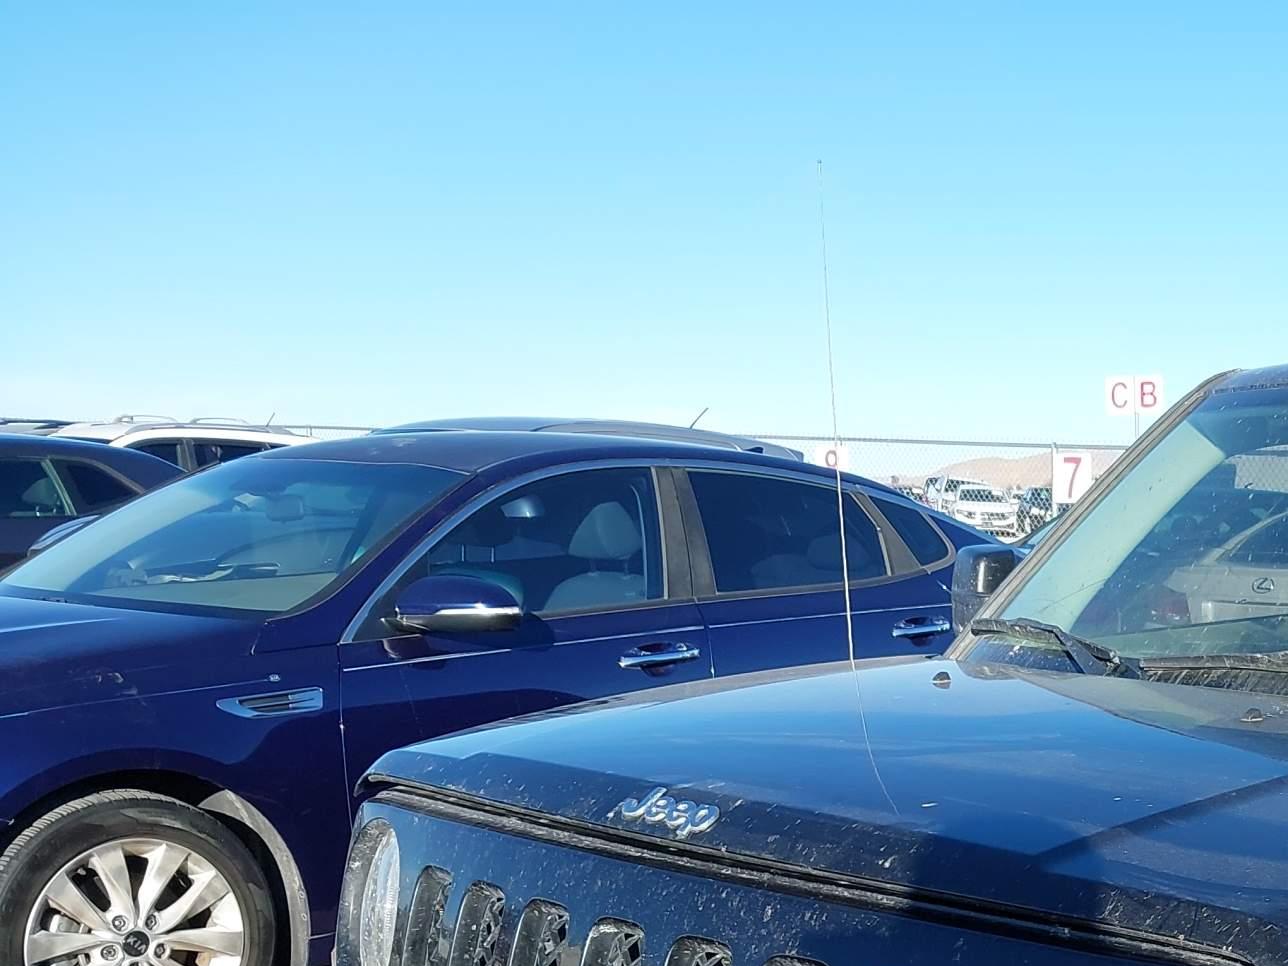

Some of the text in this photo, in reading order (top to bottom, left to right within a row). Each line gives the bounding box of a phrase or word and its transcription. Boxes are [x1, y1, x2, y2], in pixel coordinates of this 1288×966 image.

[1111, 381, 1157, 408] C B
[1063, 456, 1082, 499] 7
[622, 786, 720, 840] Jeep
